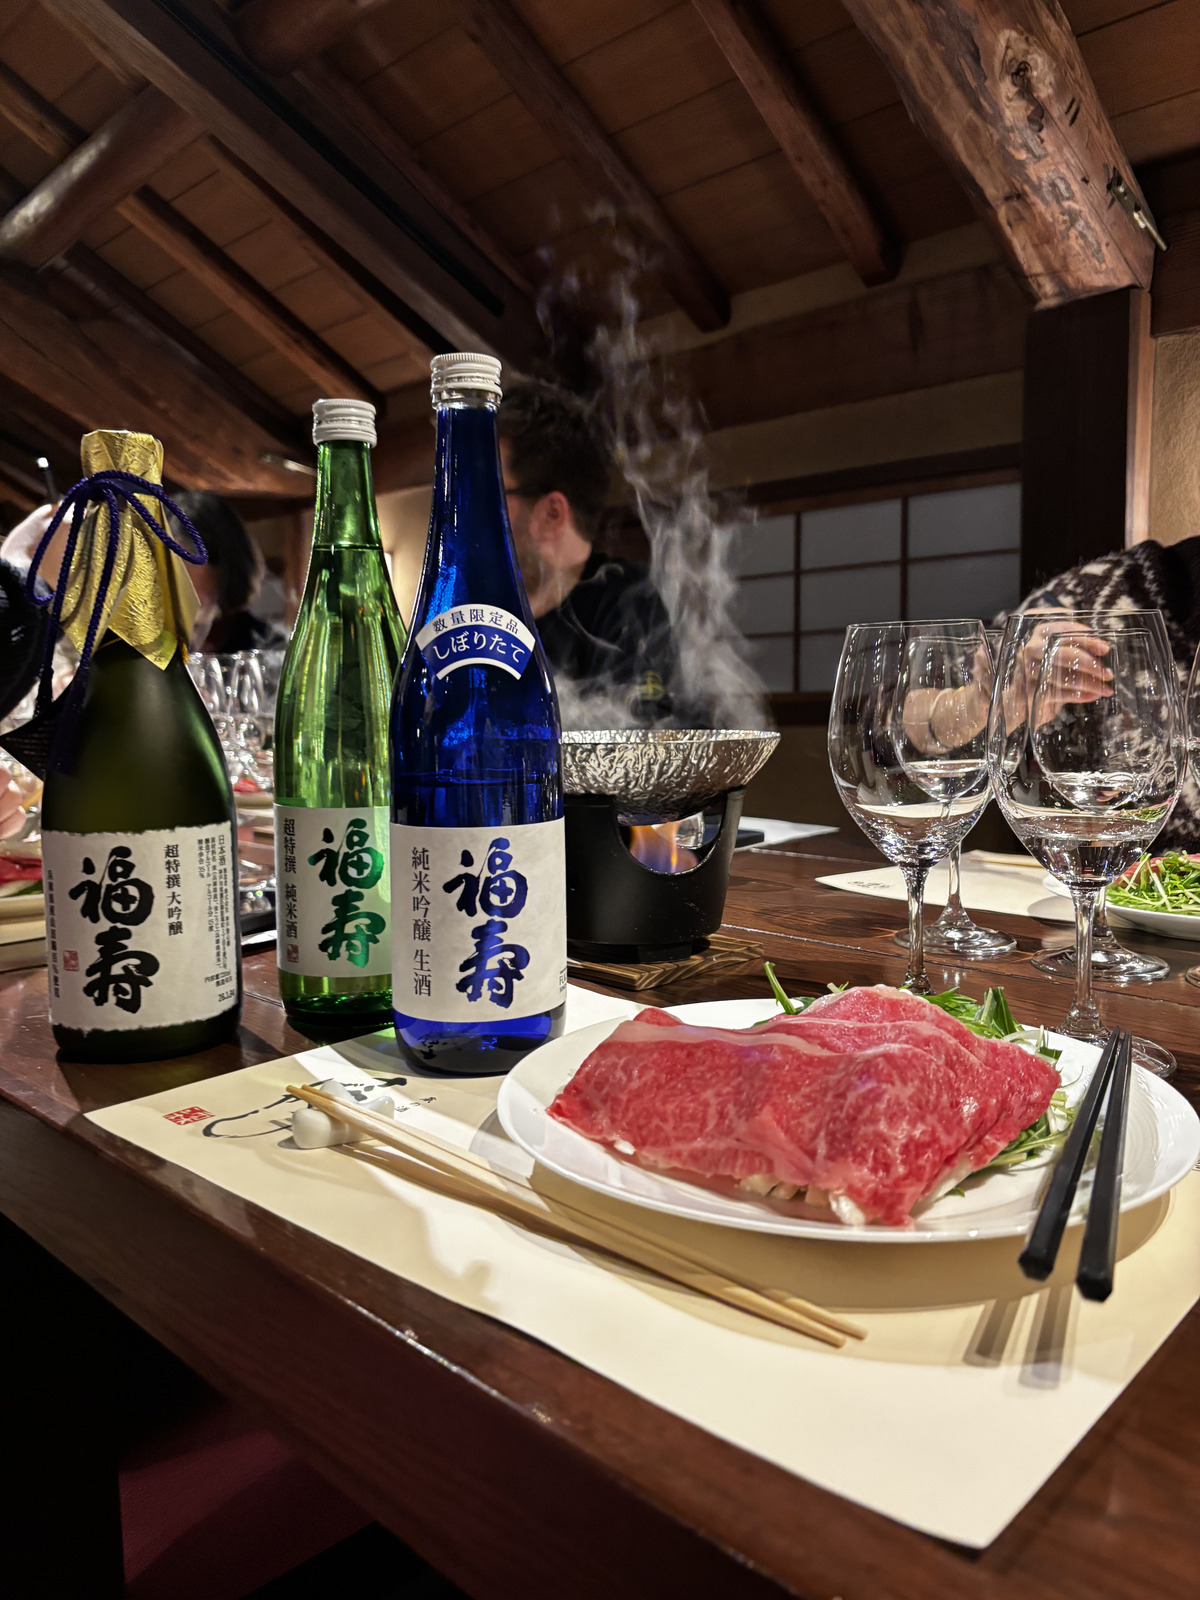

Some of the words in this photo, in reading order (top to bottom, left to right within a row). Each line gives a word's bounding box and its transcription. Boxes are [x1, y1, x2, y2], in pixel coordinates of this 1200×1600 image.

[432, 608, 519, 635] 数量限定品
[433, 630, 526, 664] しぼりたて
[69, 845, 160, 1014] 福寿
[307, 818, 386, 968] 福寿
[442, 837, 531, 1009] 福寿
